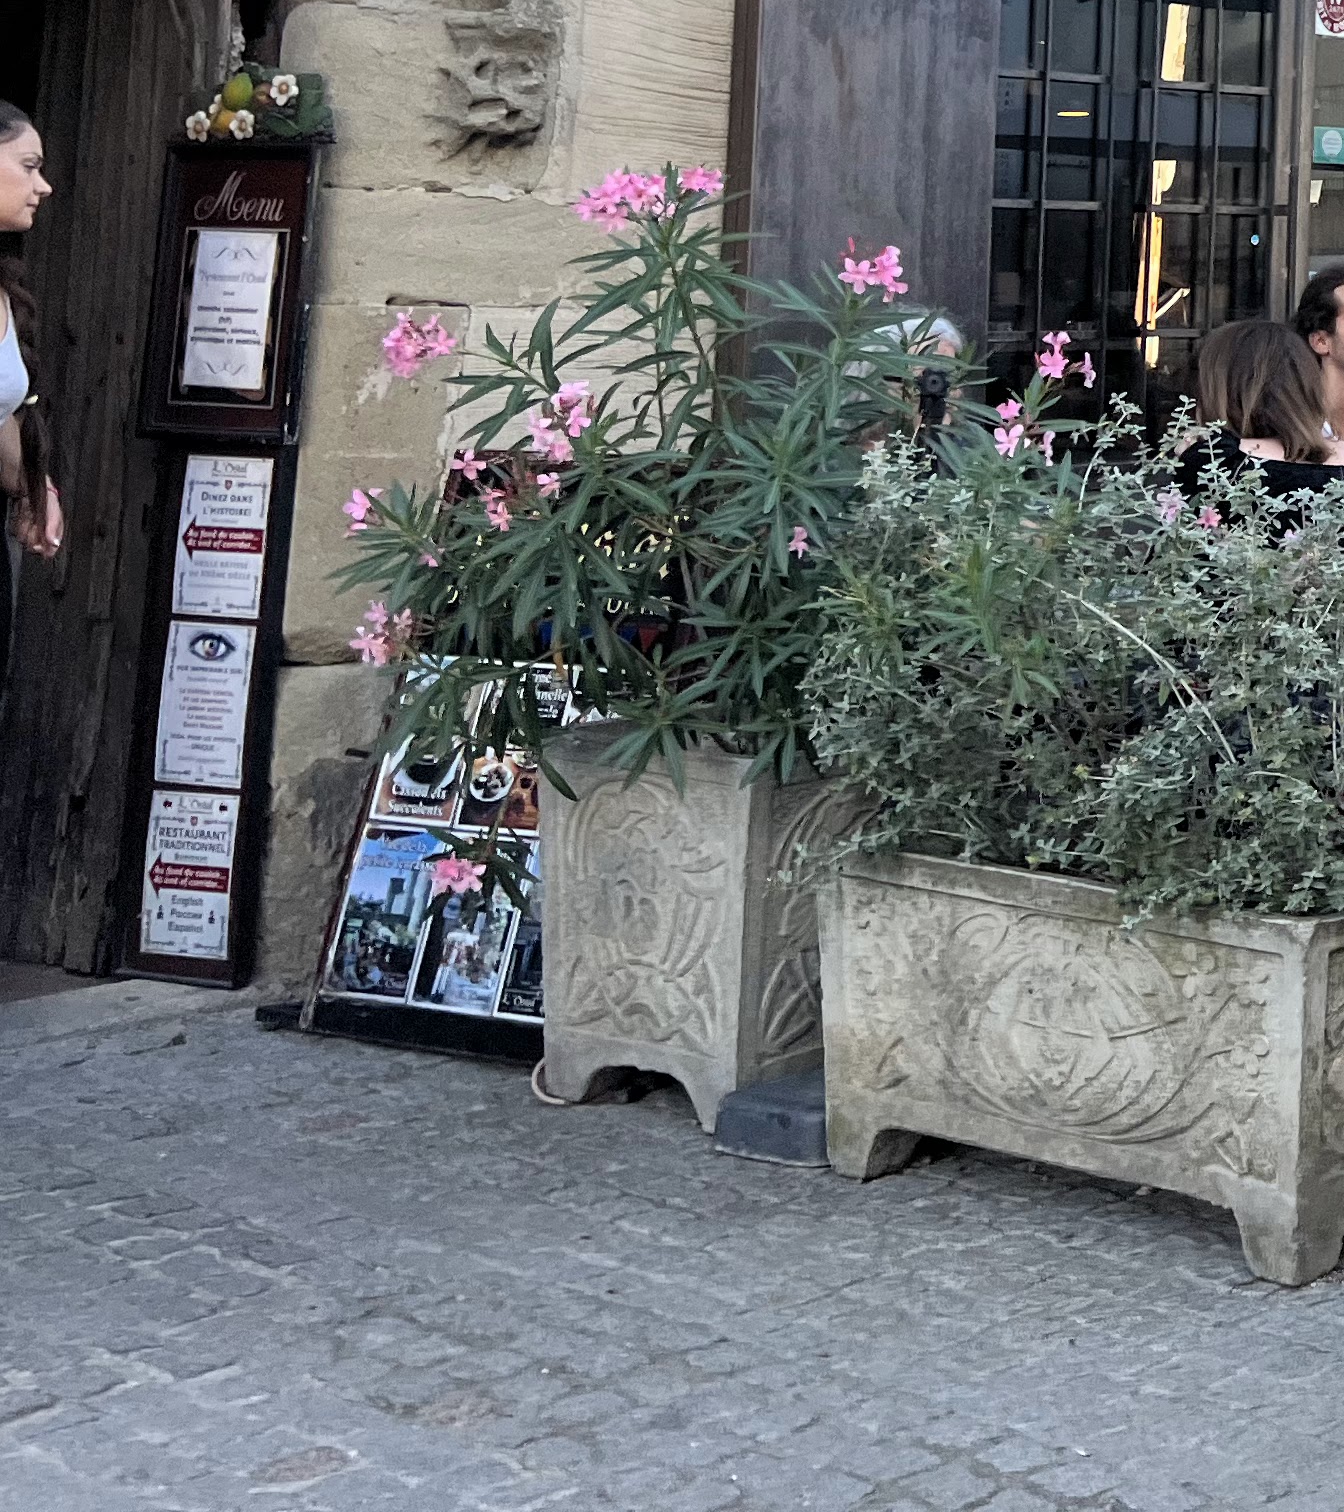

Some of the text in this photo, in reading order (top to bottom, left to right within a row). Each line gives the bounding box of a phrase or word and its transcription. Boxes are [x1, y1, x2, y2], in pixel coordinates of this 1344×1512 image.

[193, 170, 284, 222] Menu
[158, 826, 227, 841] RESTAURANT
[158, 838, 227, 854] TRADITIONNEL
